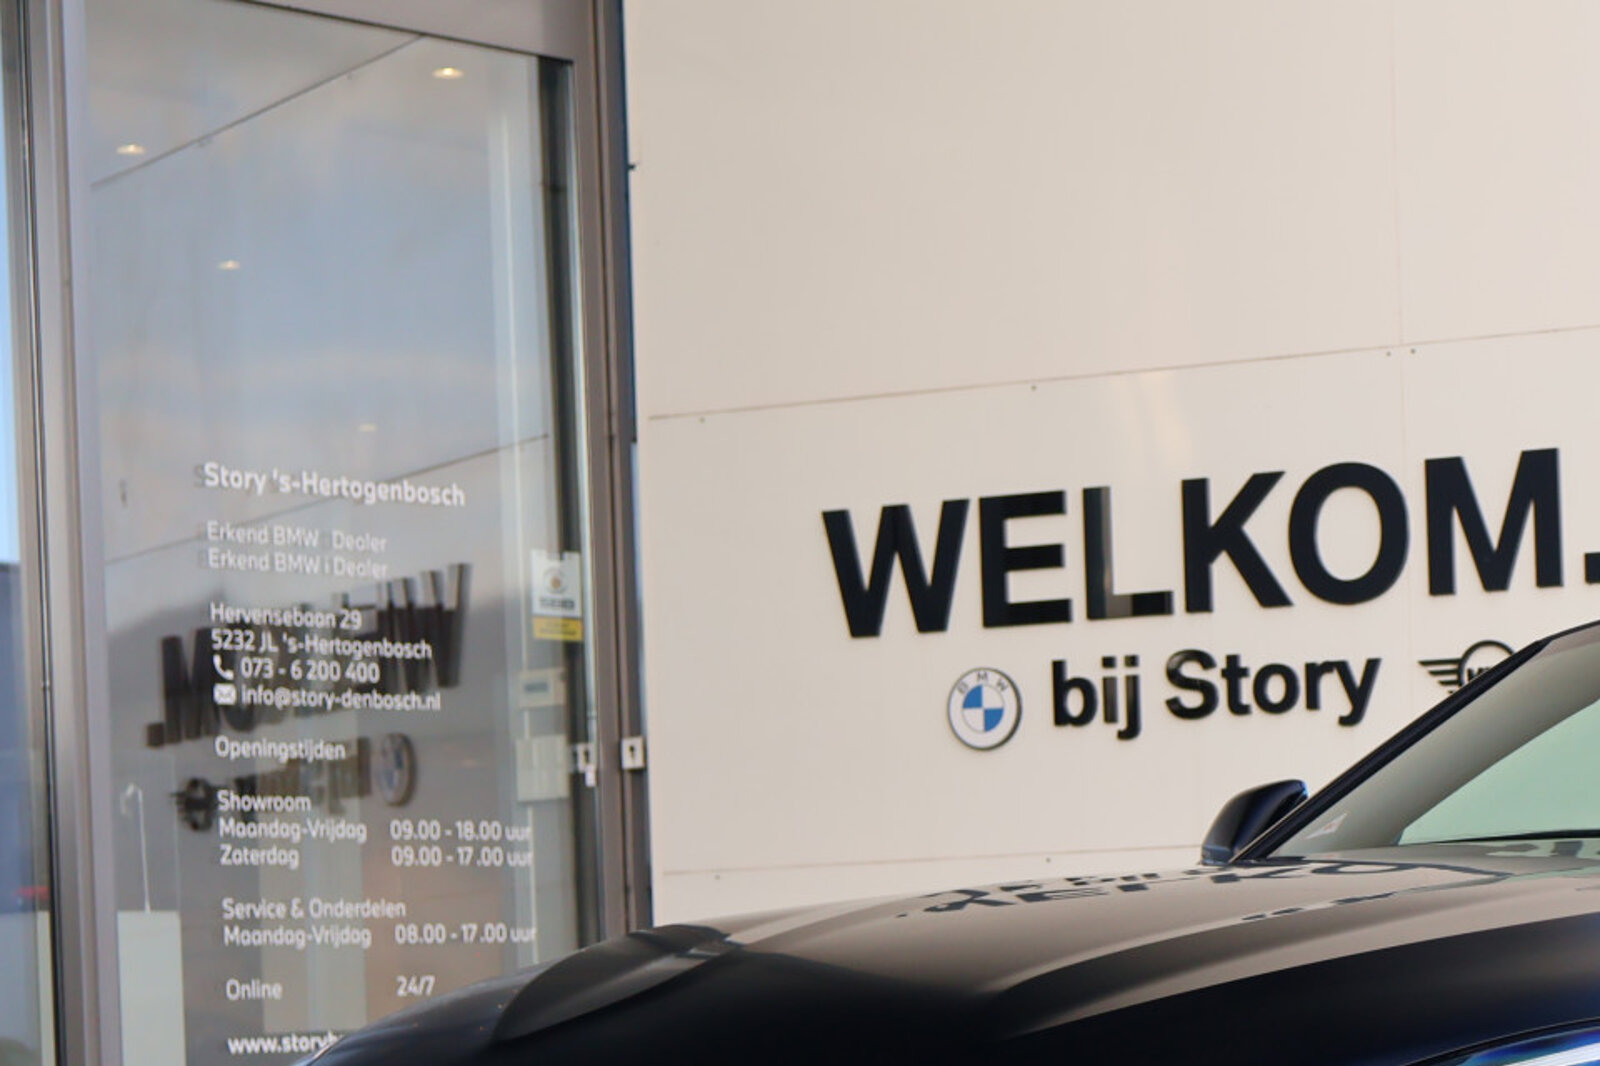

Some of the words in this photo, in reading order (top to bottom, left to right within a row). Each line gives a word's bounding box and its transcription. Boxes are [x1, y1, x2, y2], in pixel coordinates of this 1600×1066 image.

[204, 462, 266, 495] Story
[272, 468, 466, 507] 's-Hertogenbosch
[207, 520, 268, 545] Erkend
[273, 526, 319, 547] BMW
[332, 530, 387, 553] Dealer
[208, 548, 269, 571] Erkend
[274, 552, 320, 574] BMW
[333, 556, 388, 579] Dealer
[210, 603, 335, 629] Hervensebaan
[340, 609, 362, 630] 29
[211, 629, 255, 651] 5232
[259, 631, 279, 653] JL
[282, 632, 432, 660] 's-Hertogenbosch
[240, 656, 274, 680] 073
[290, 660, 302, 681] 6
[306, 660, 340, 682] 200
[345, 661, 380, 684] 400
[241, 684, 441, 711] info@story-denbosch.nl
[1052, 654, 1141, 741] bij
[1165, 649, 1382, 727] Story
[214, 735, 345, 762] Openingstijden
[216, 790, 311, 812] Showroom
[218, 818, 367, 844] Maandag-Vrijdag
[389, 819, 441, 841] 09.00
[455, 820, 502, 841] 18.00
[505, 825, 532, 841] uur
[220, 844, 299, 869] Zaterdag
[391, 846, 442, 867] 09.00
[507, 851, 533, 867] uur
[222, 898, 285, 920] Service
[290, 899, 304, 919] &
[309, 899, 406, 919] Onderdelen
[223, 925, 371, 949] Maandag-Vrijdag
[395, 924, 446, 944] 08.00
[510, 927, 536, 943] uur
[226, 978, 283, 1000] Online
[396, 975, 435, 997] 24/7
